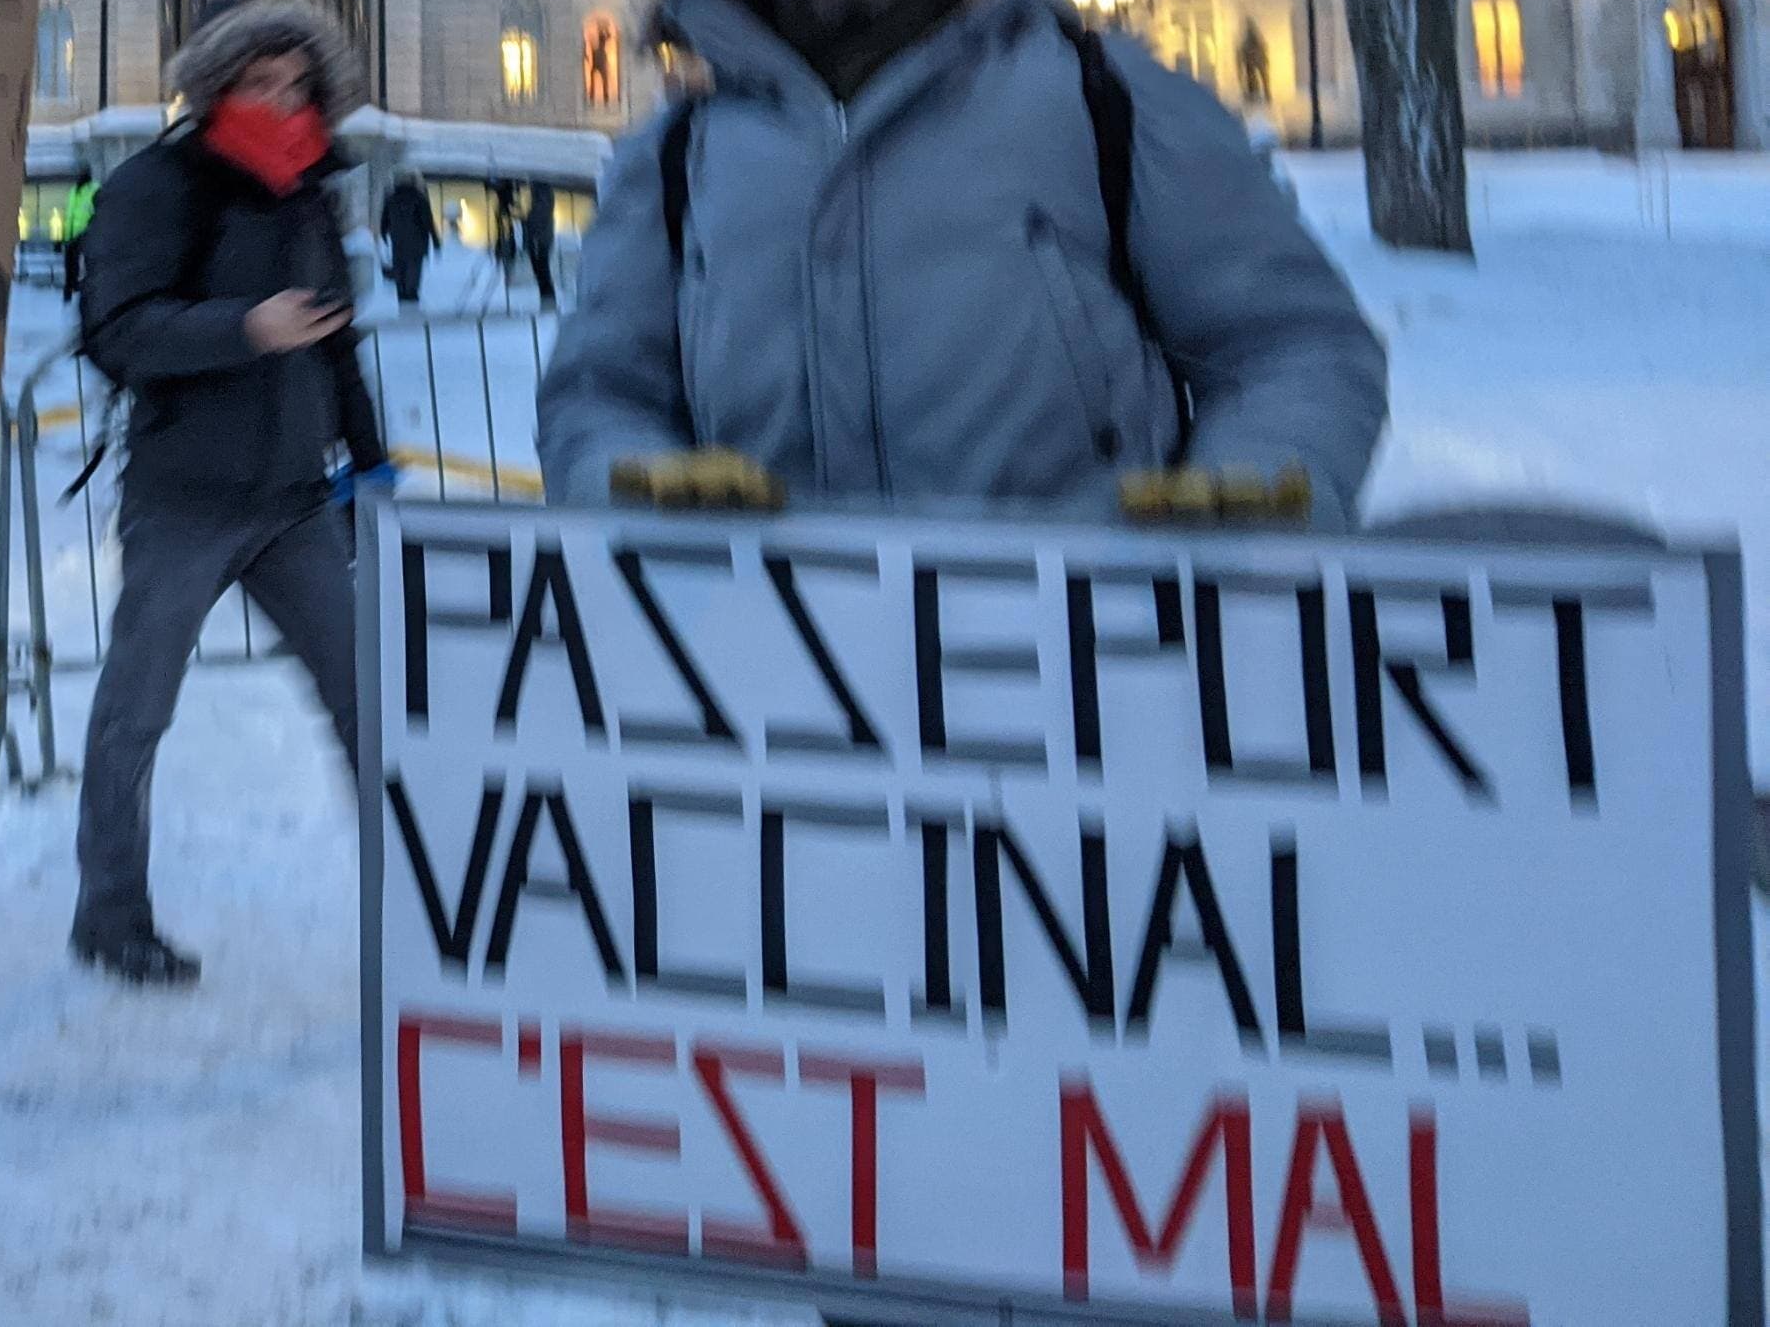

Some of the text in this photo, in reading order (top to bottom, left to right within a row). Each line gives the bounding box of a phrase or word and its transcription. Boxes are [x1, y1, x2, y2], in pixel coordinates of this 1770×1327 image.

[402, 530, 1654, 815] PASSEPORT
[398, 1007, 1531, 1327] C'EST MAL
